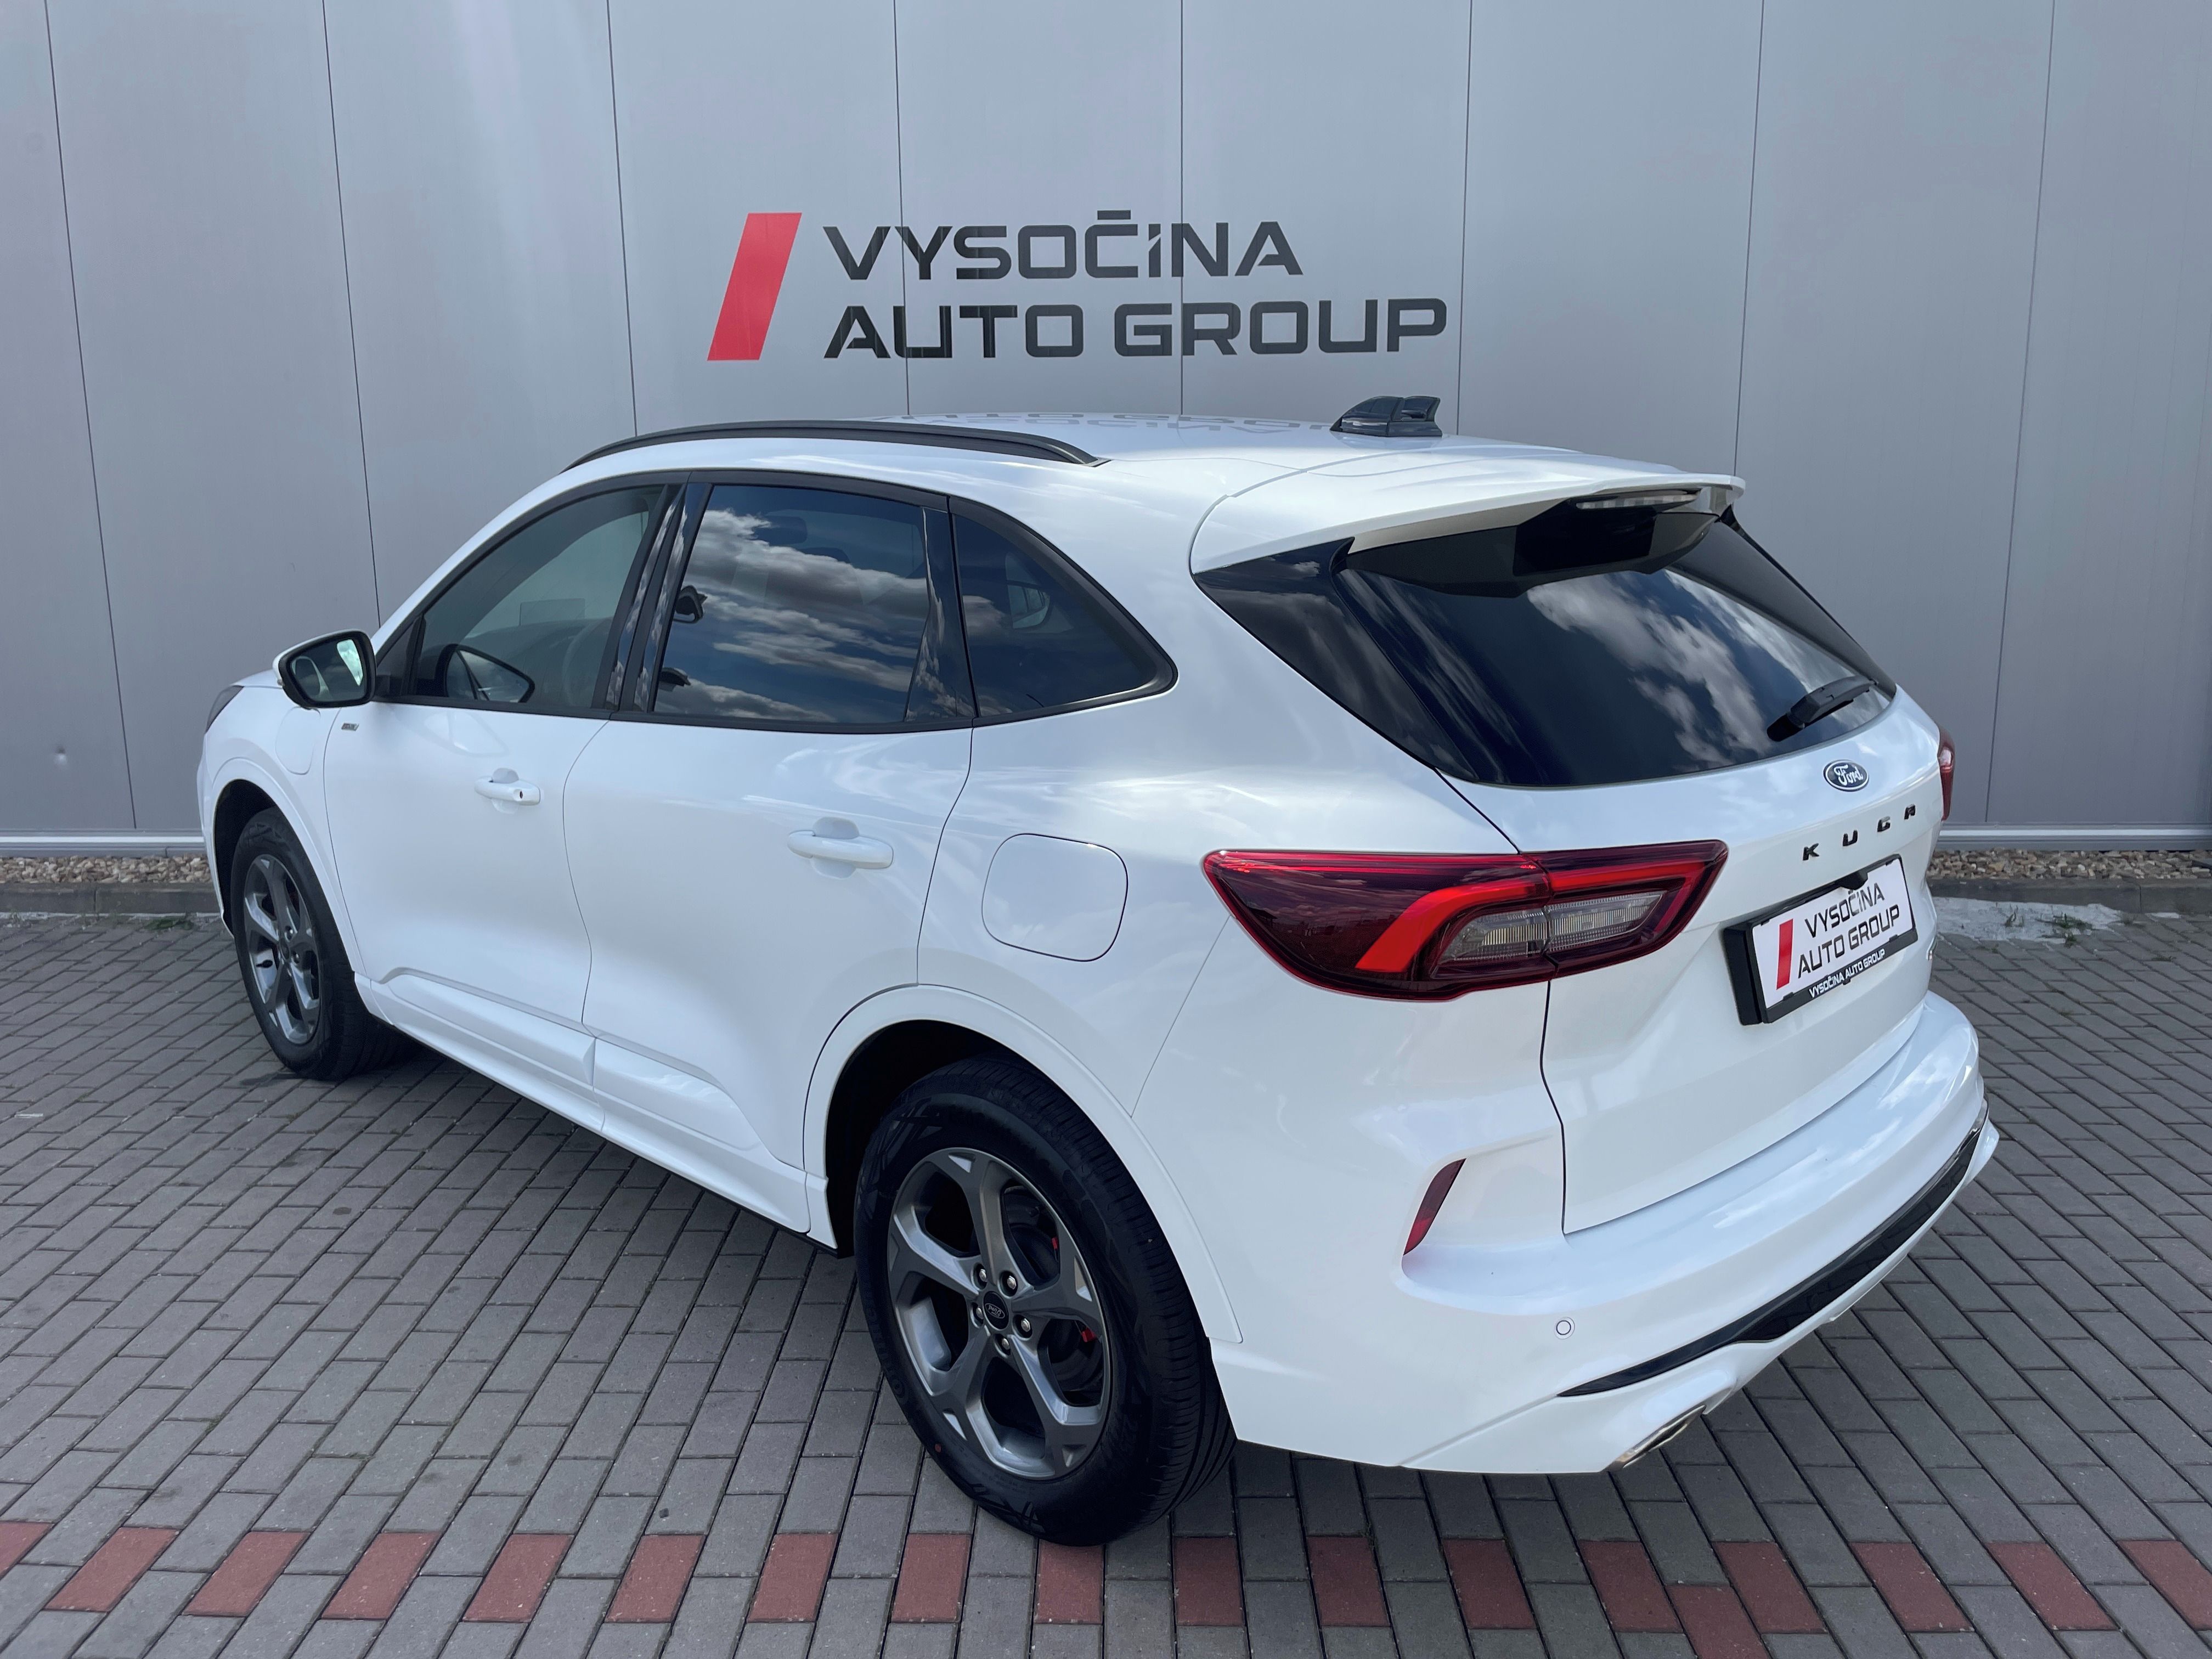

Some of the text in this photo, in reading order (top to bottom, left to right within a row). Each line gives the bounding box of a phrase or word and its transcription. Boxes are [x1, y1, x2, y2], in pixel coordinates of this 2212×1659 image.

[822, 209, 1304, 281] VYSOČINA
[822, 297, 1448, 360] AUTO GROUP
[1833, 764, 1864, 786] Ford
[1803, 804, 1916, 861] KUGA
[1804, 883, 1885, 938] VYSOČINA
[1798, 904, 1899, 979] AUTO GROUP
[1809, 948, 1886, 998] VYSOČINA AUTO GROUP
